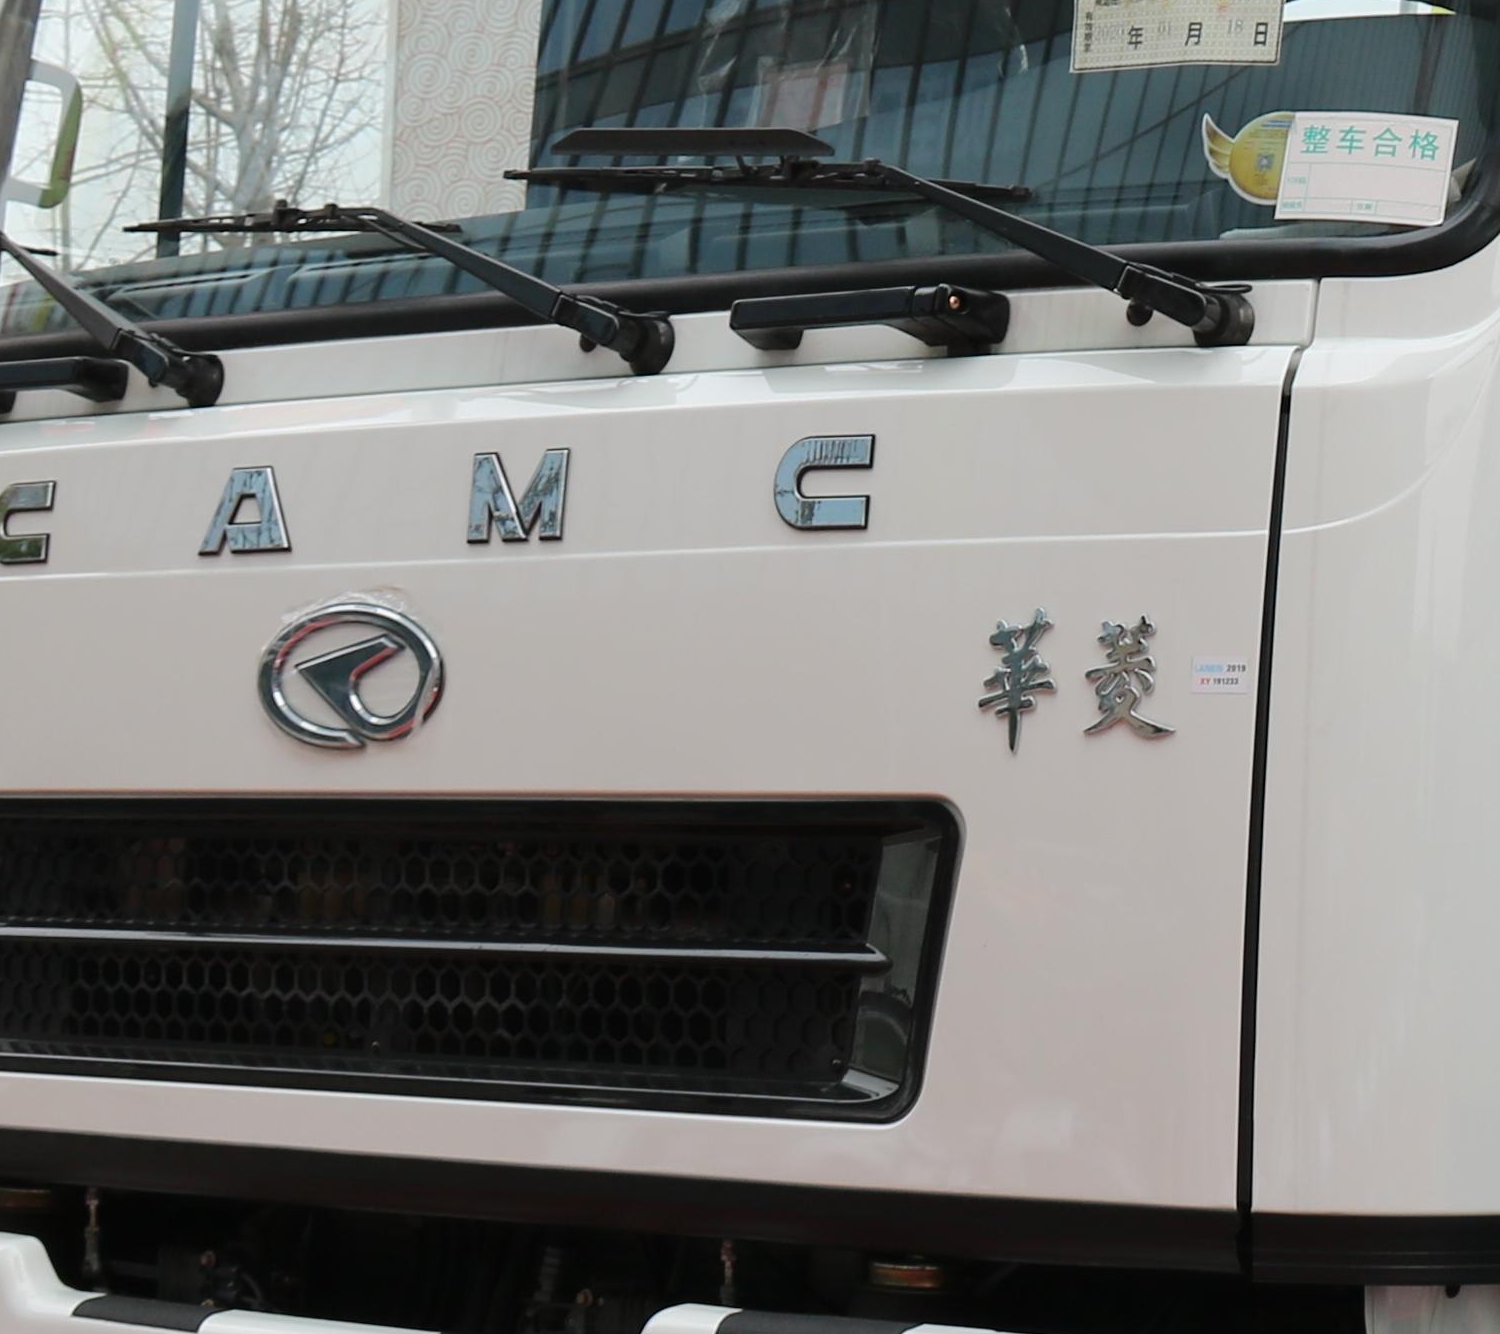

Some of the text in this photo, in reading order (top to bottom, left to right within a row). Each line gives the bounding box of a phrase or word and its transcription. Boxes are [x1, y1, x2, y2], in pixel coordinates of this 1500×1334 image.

[1127, 25, 1144, 50] 年
[1184, 22, 1203, 46] 月
[1253, 22, 1269, 46] 日
[1301, 124, 1440, 161] 整车合格
